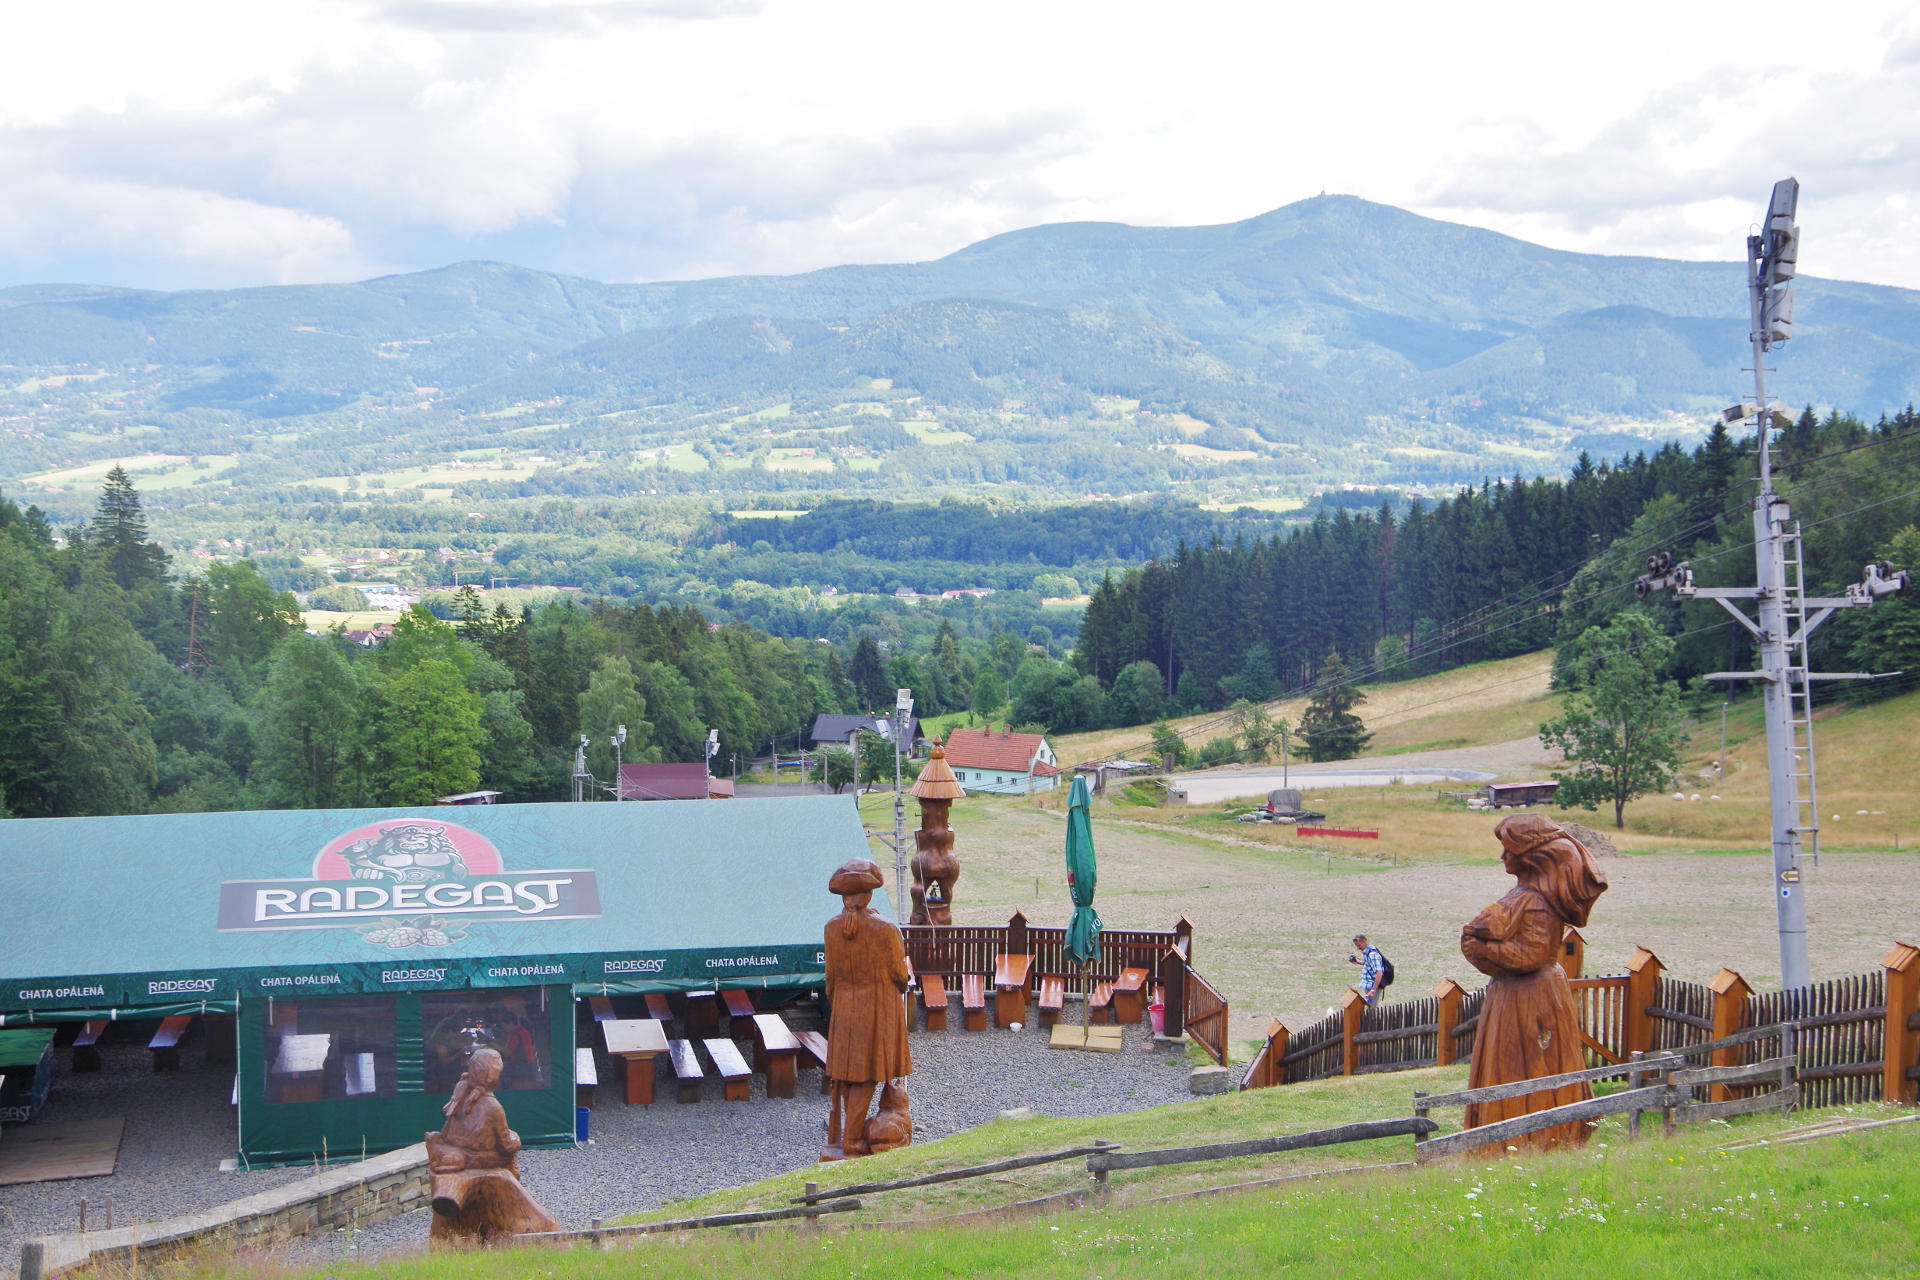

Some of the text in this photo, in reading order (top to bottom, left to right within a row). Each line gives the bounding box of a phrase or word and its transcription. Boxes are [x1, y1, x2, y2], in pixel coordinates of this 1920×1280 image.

[254, 877, 573, 922] RADEGAST
[604, 958, 667, 974] RADEGAST
[705, 955, 779, 968] CHATA OPÁLENÁ
[382, 967, 448, 984] RADEGAST
[488, 963, 564, 977] CHATA OPÁLENÁ
[148, 978, 218, 995] RADEGAST
[260, 972, 341, 987] CHATA OPÁLENÁ
[19, 984, 105, 1000] CHATA OPÁLENÁ
